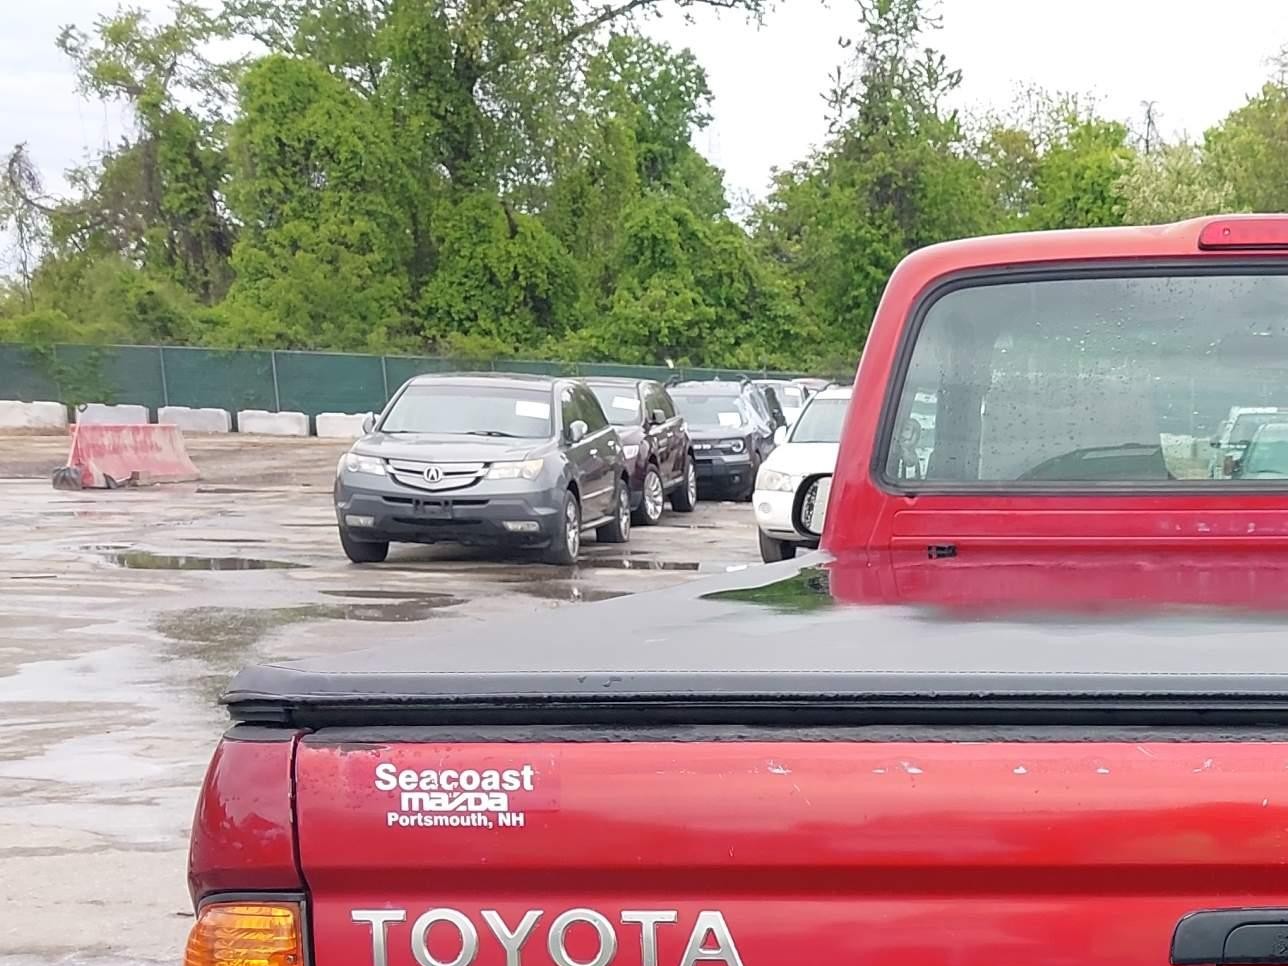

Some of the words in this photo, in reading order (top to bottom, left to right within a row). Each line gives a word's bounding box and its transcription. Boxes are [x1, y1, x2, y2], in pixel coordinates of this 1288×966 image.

[375, 763, 534, 791] Seacoast
[387, 812, 493, 828] Portsmouth,
[498, 812, 525, 827] NH
